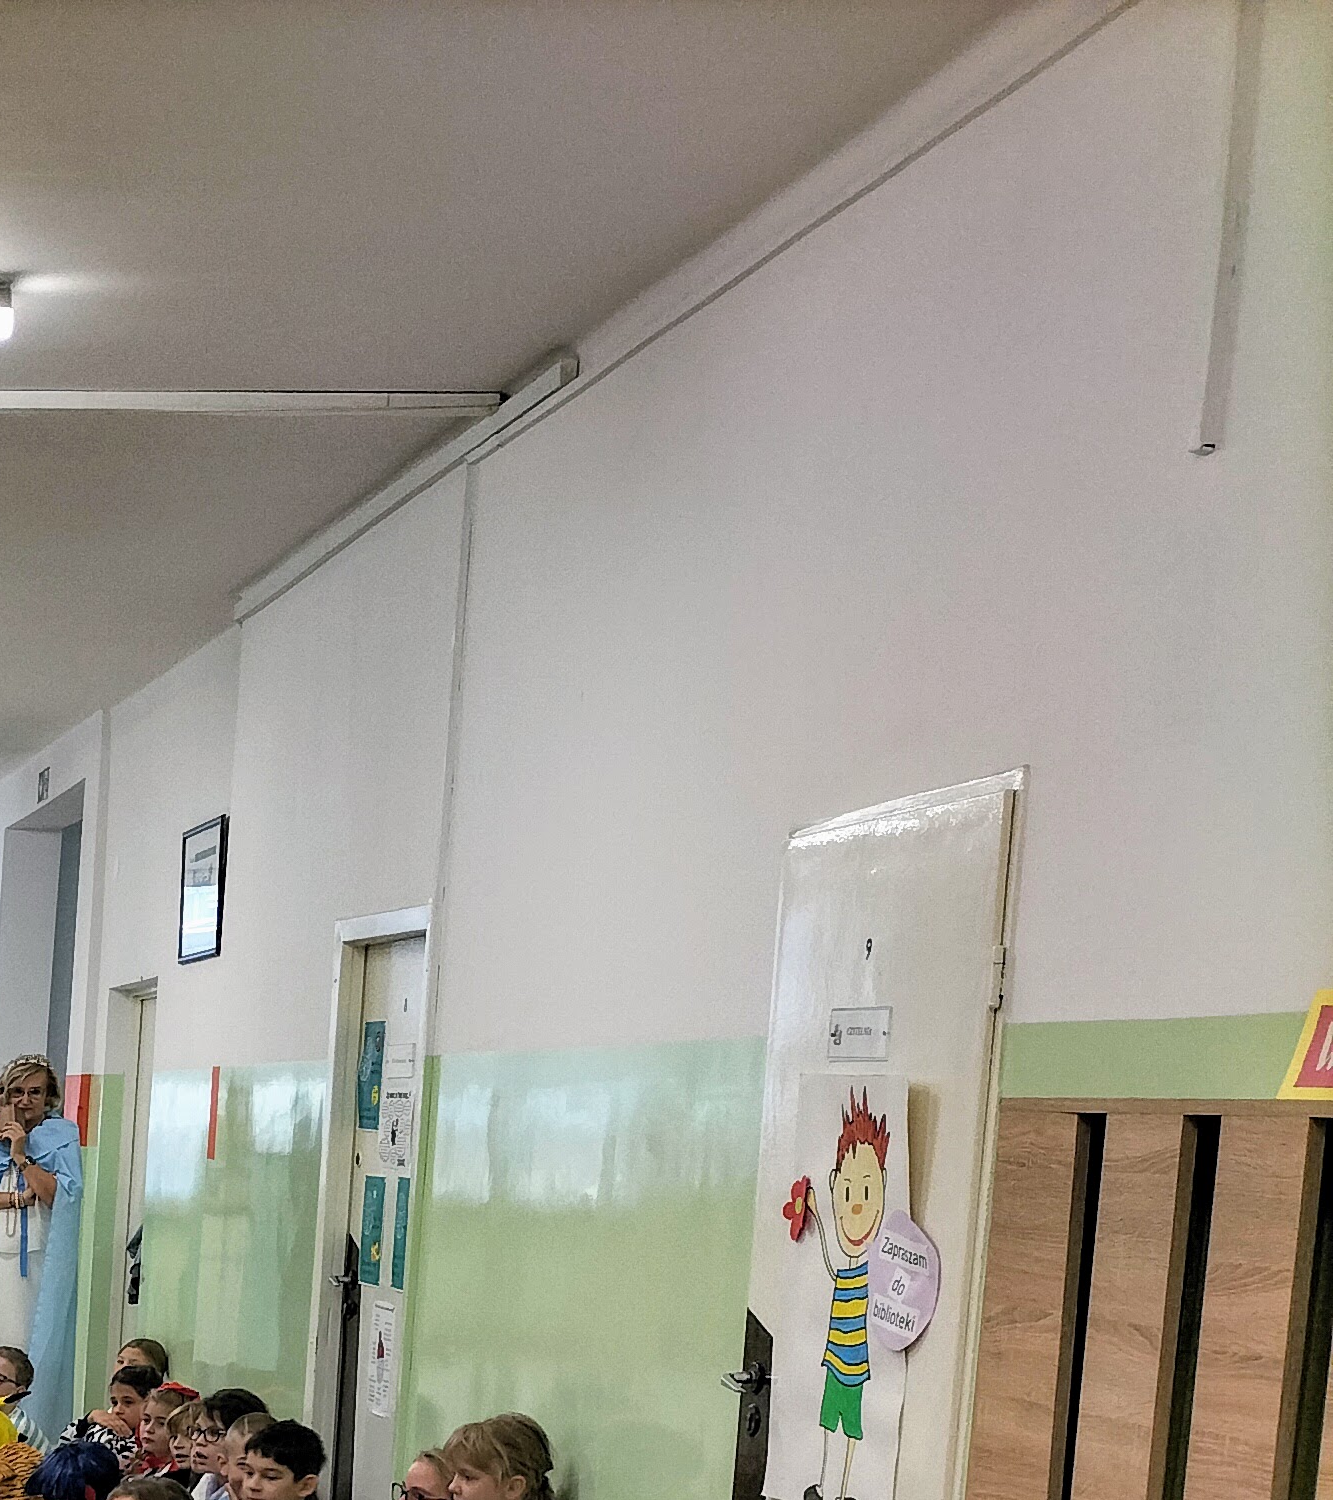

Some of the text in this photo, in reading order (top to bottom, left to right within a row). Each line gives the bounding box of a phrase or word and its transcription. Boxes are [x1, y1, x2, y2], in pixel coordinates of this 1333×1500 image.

[881, 1236, 928, 1270] Zapraszam
[891, 1275, 906, 1296] do
[872, 1298, 917, 1333] biblioteki
